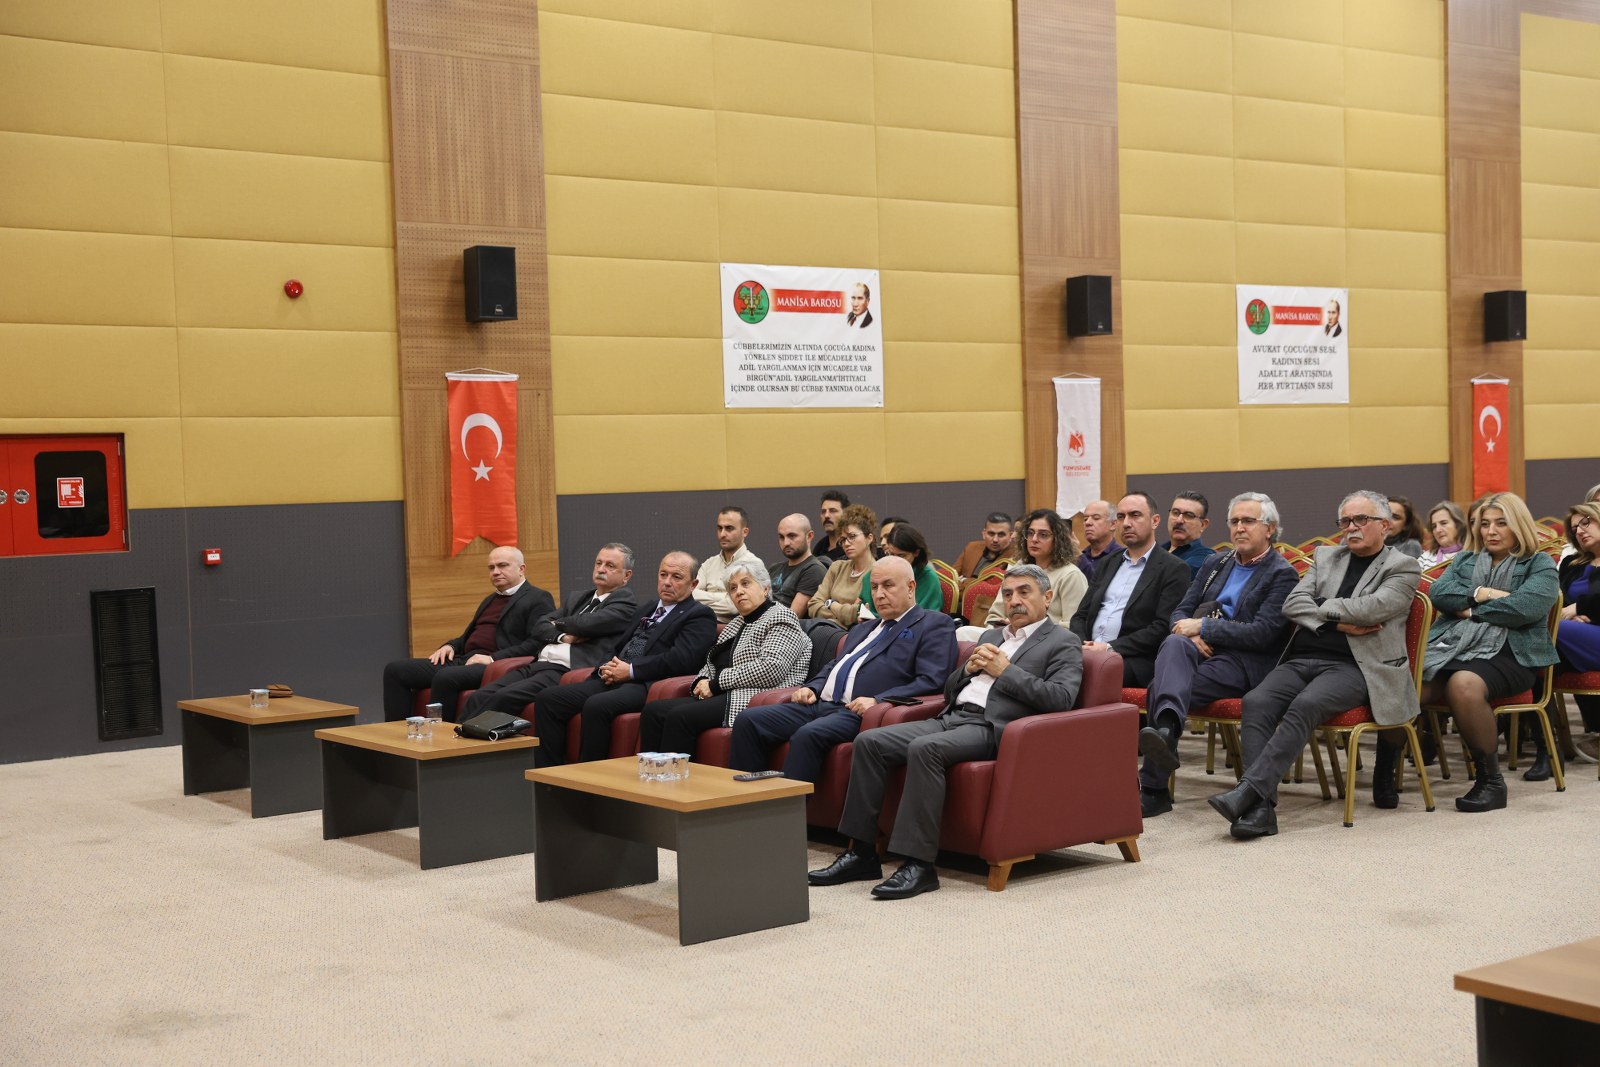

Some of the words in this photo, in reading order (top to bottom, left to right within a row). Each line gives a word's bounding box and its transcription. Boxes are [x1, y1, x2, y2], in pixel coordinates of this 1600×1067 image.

[777, 296, 808, 307] MANİSA
[811, 298, 841, 308] BAROSU
[1283, 345, 1317, 354] ÇOCUĞUN
[1290, 370, 1332, 379] ARAYIŞINDA
[731, 384, 755, 393] İÇİNDE
[1276, 382, 1315, 391] YURTTAŞIN
